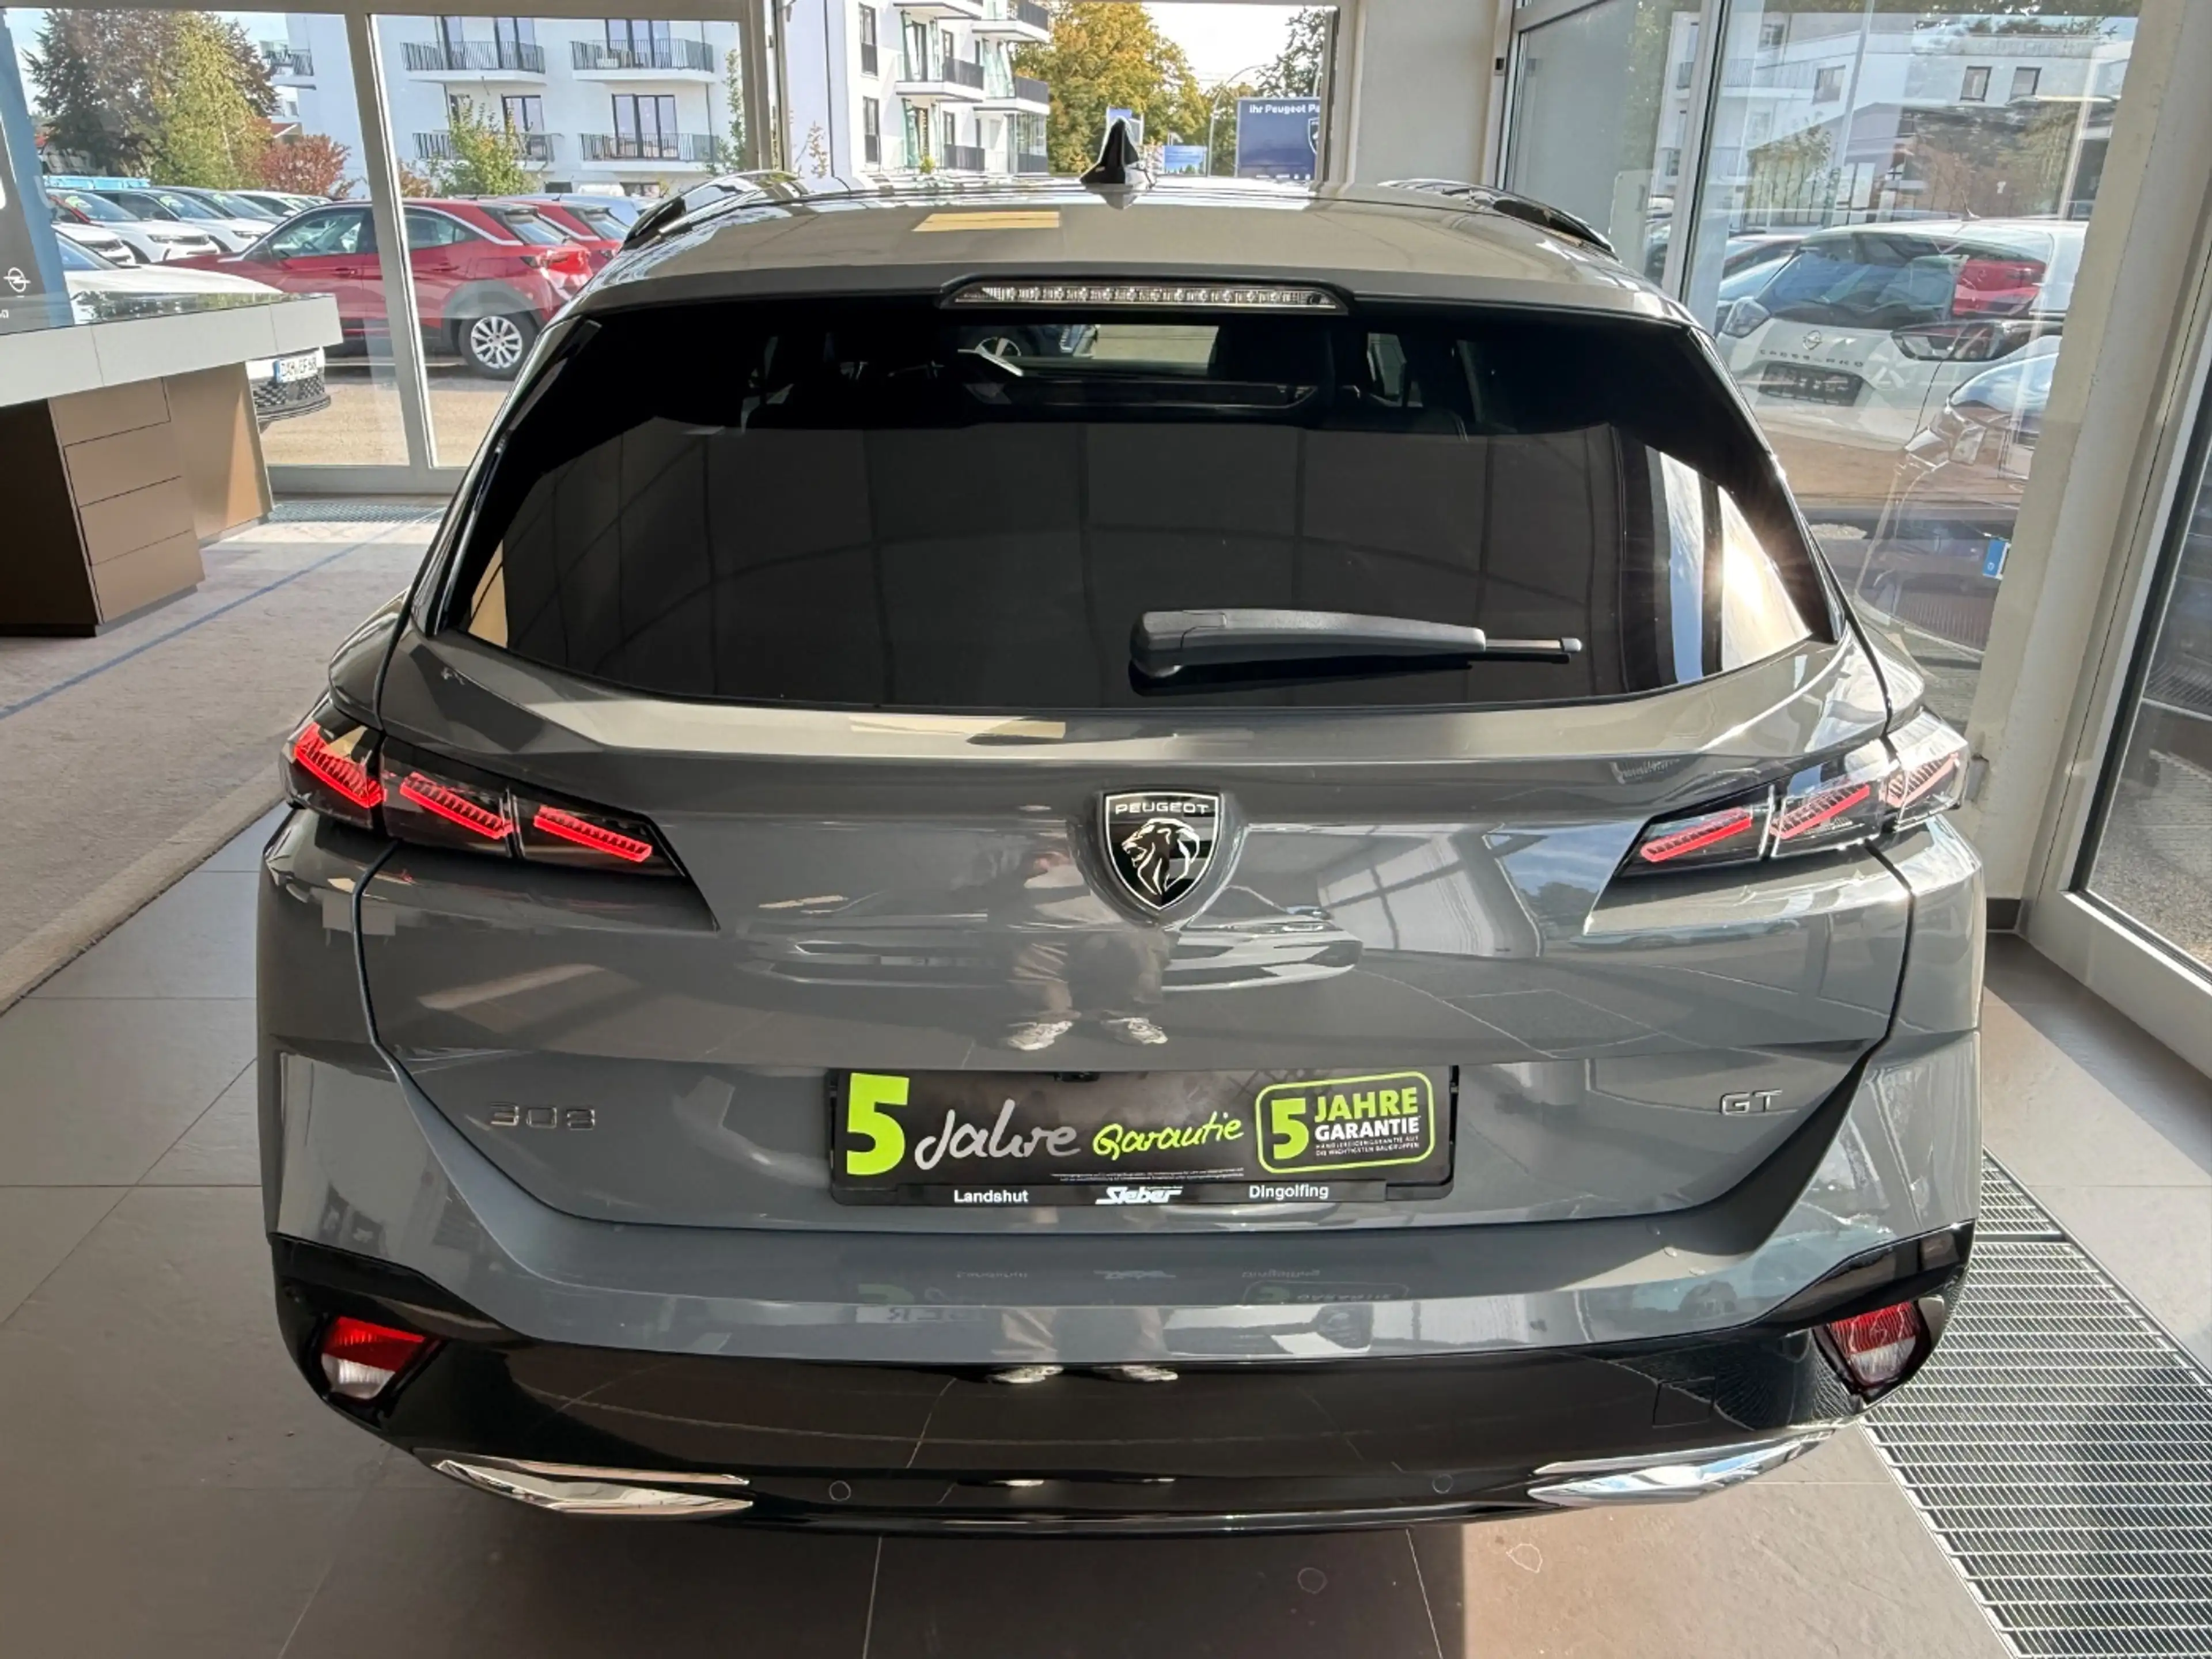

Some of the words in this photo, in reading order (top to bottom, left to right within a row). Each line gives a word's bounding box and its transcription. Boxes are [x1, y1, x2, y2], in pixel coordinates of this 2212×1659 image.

[1249, 104, 1263, 113] Ihr
[1265, 104, 1306, 115] Peugeot
[1115, 802, 1210, 815] PEUGEOT
[1719, 1088, 1783, 1116] GT
[490, 1101, 596, 1131] 308
[847, 1073, 910, 1175] 5
[915, 1098, 1081, 1170] Jahre
[1093, 1111, 1244, 1161] Garantie
[1271, 1098, 1309, 1160] 5
[1314, 1086, 1418, 1123] JAHRE
[1315, 1116, 1420, 1142] GARANTIE
[953, 1189, 1029, 1204] Landshut
[1249, 1184, 1330, 1200] Dingolfing
